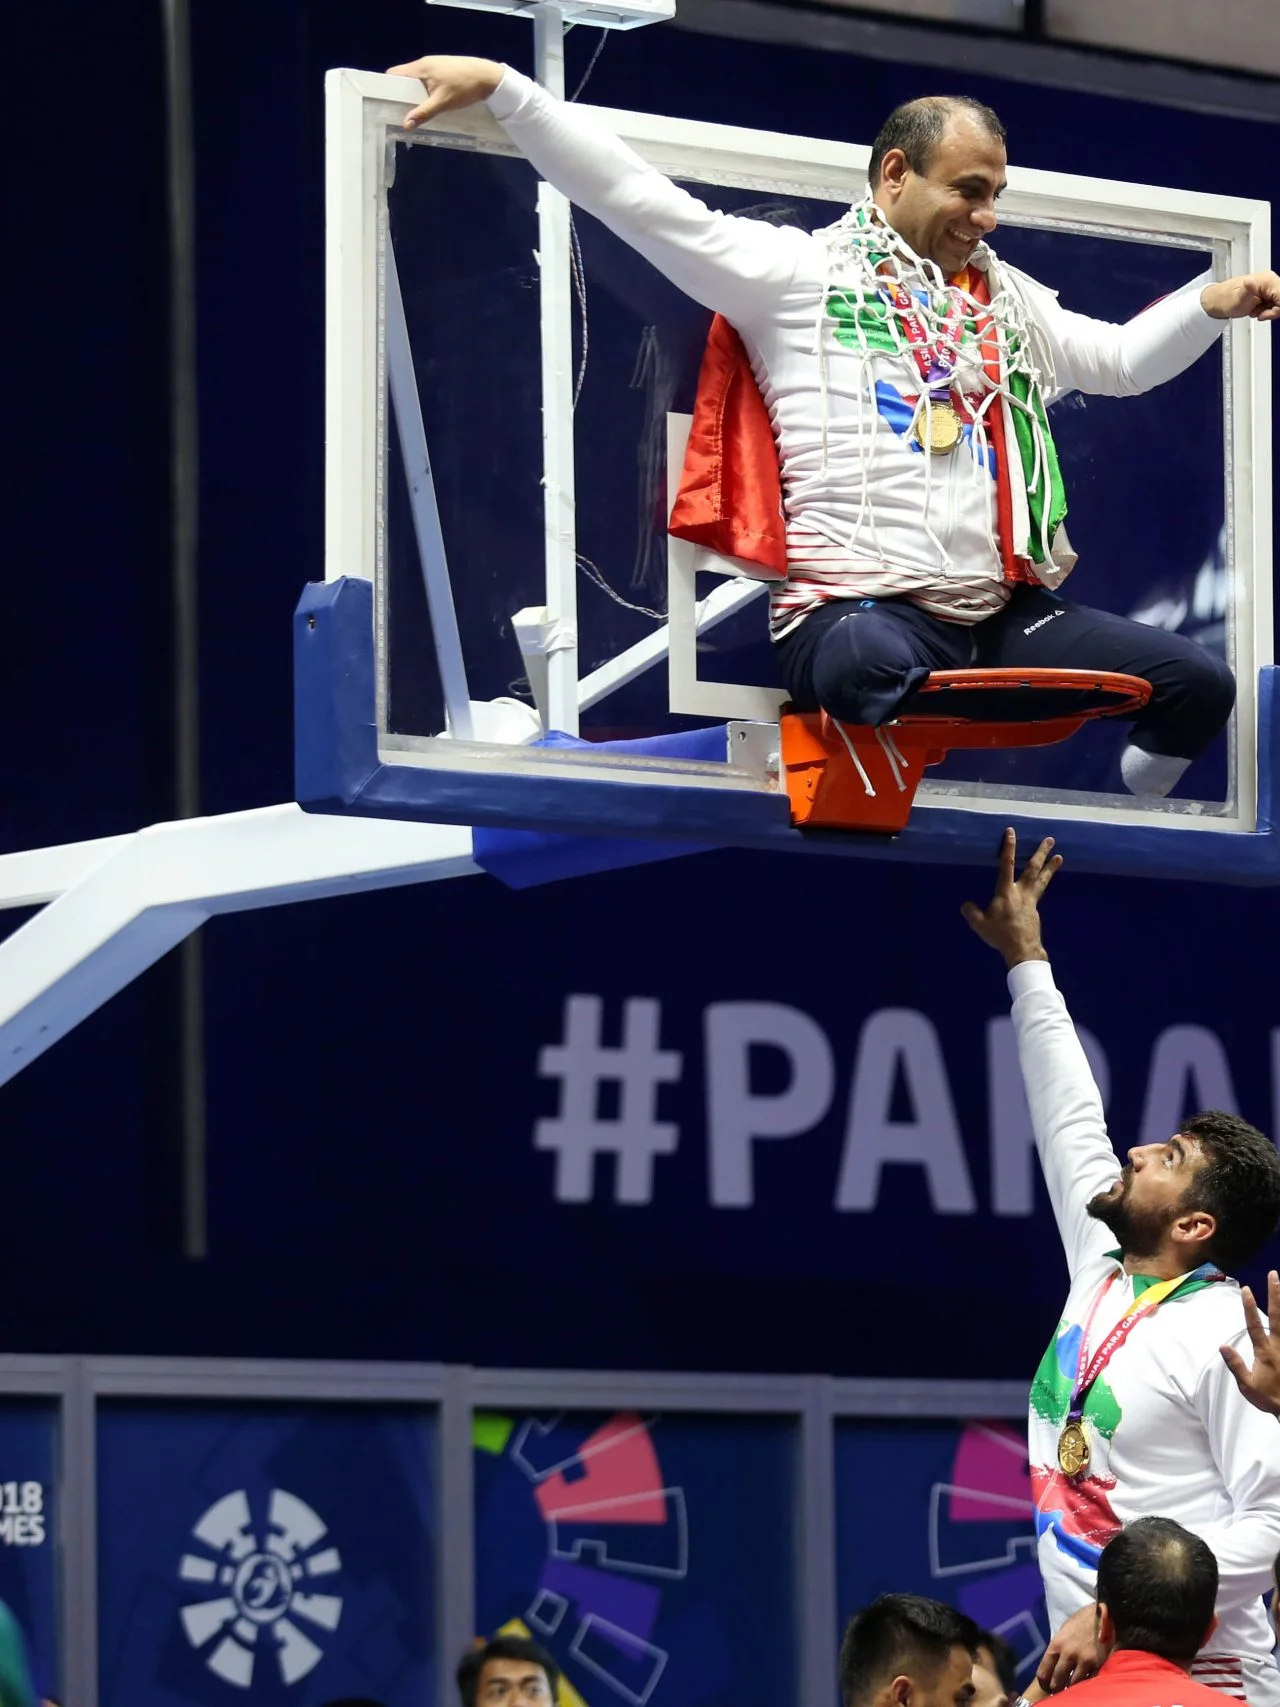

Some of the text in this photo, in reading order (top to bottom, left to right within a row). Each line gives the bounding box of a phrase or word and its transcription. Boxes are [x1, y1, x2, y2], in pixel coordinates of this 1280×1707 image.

[914, 336, 932, 367] ASIN
[1023, 614, 1056, 635] Reebok
[1101, 1330, 1124, 1355] PARA
[0, 1480, 43, 1514] 18
[0, 1514, 46, 1547] MES
